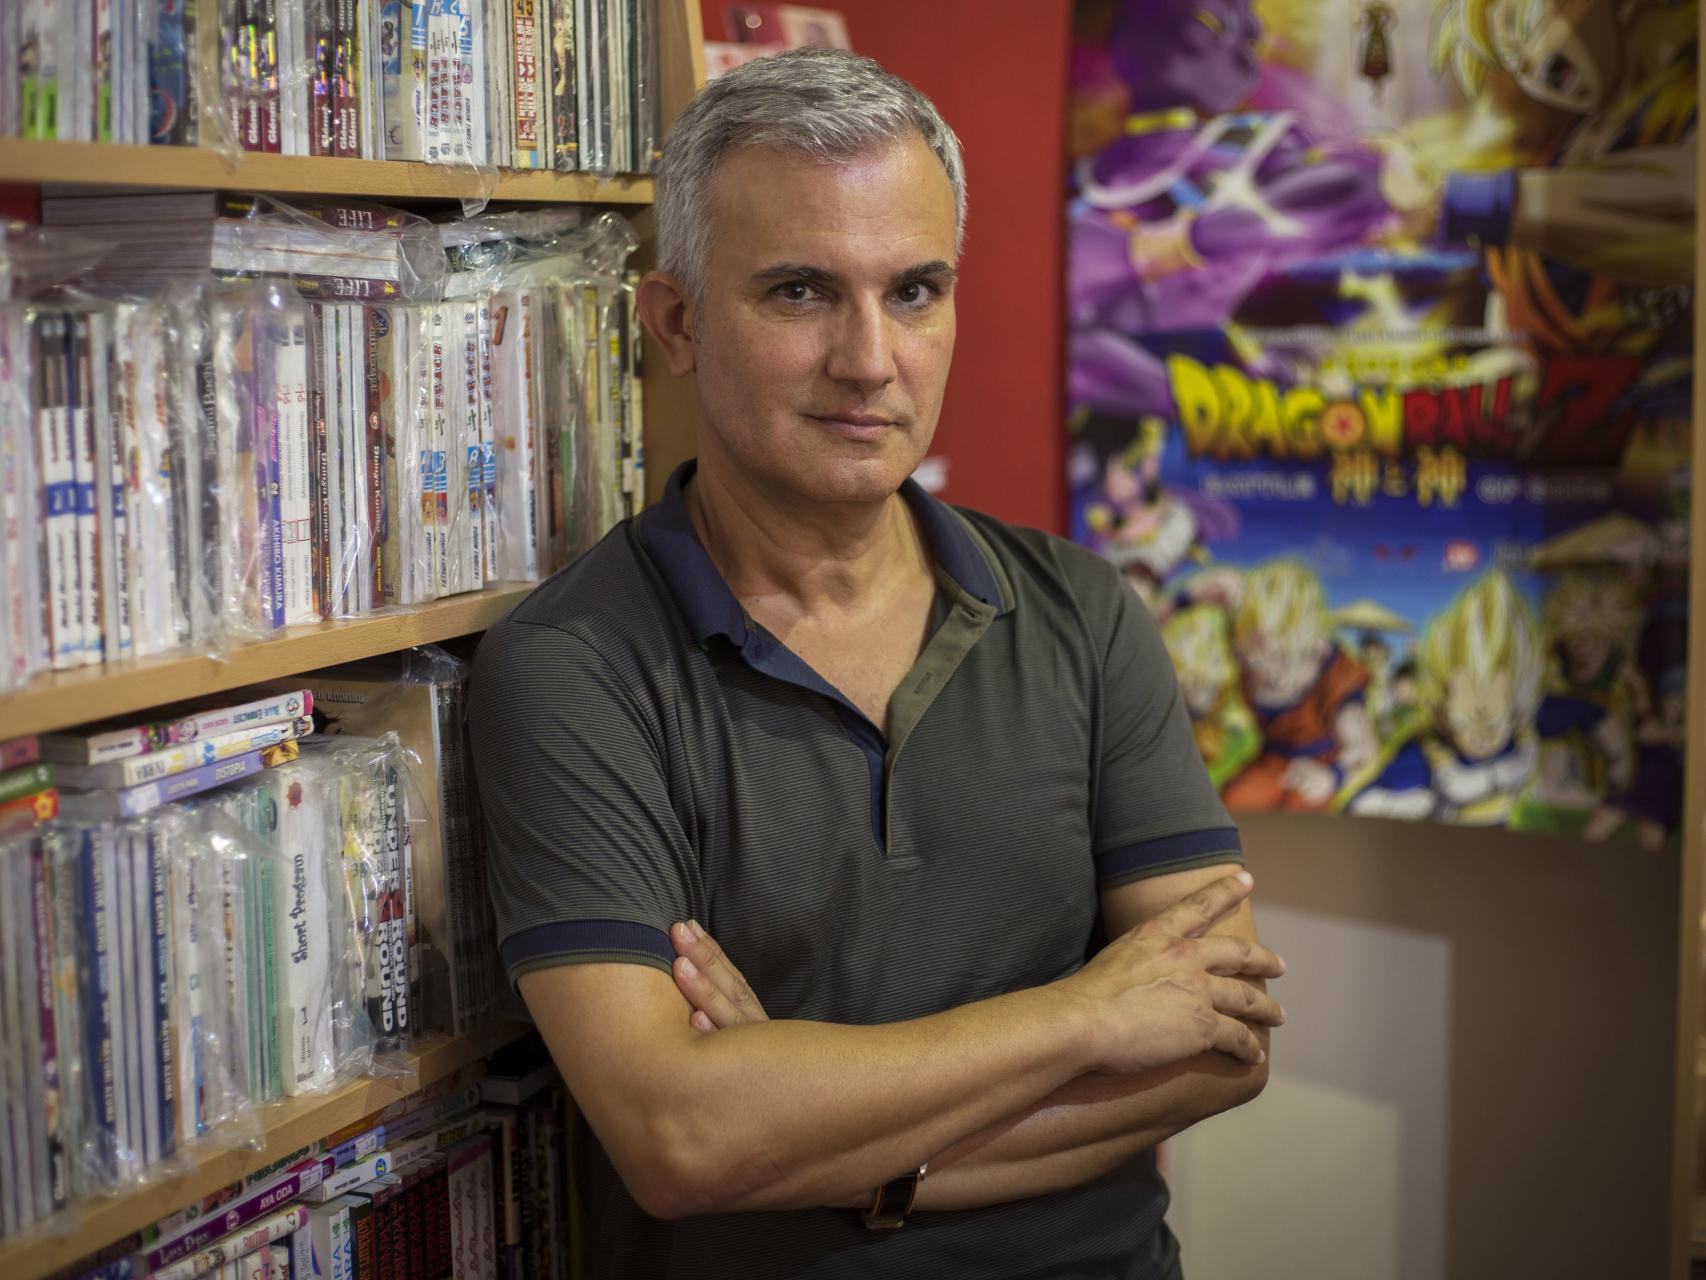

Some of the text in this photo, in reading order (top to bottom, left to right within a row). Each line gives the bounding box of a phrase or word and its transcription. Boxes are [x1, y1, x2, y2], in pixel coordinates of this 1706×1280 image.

[336, 208, 375, 229] LIFE
[334, 278, 369, 297] LIFE
[272, 519, 283, 610] AKIHIRO KIMURA
[288, 853, 307, 965] Short Program
[258, 1183, 294, 1210] AYA ODA
